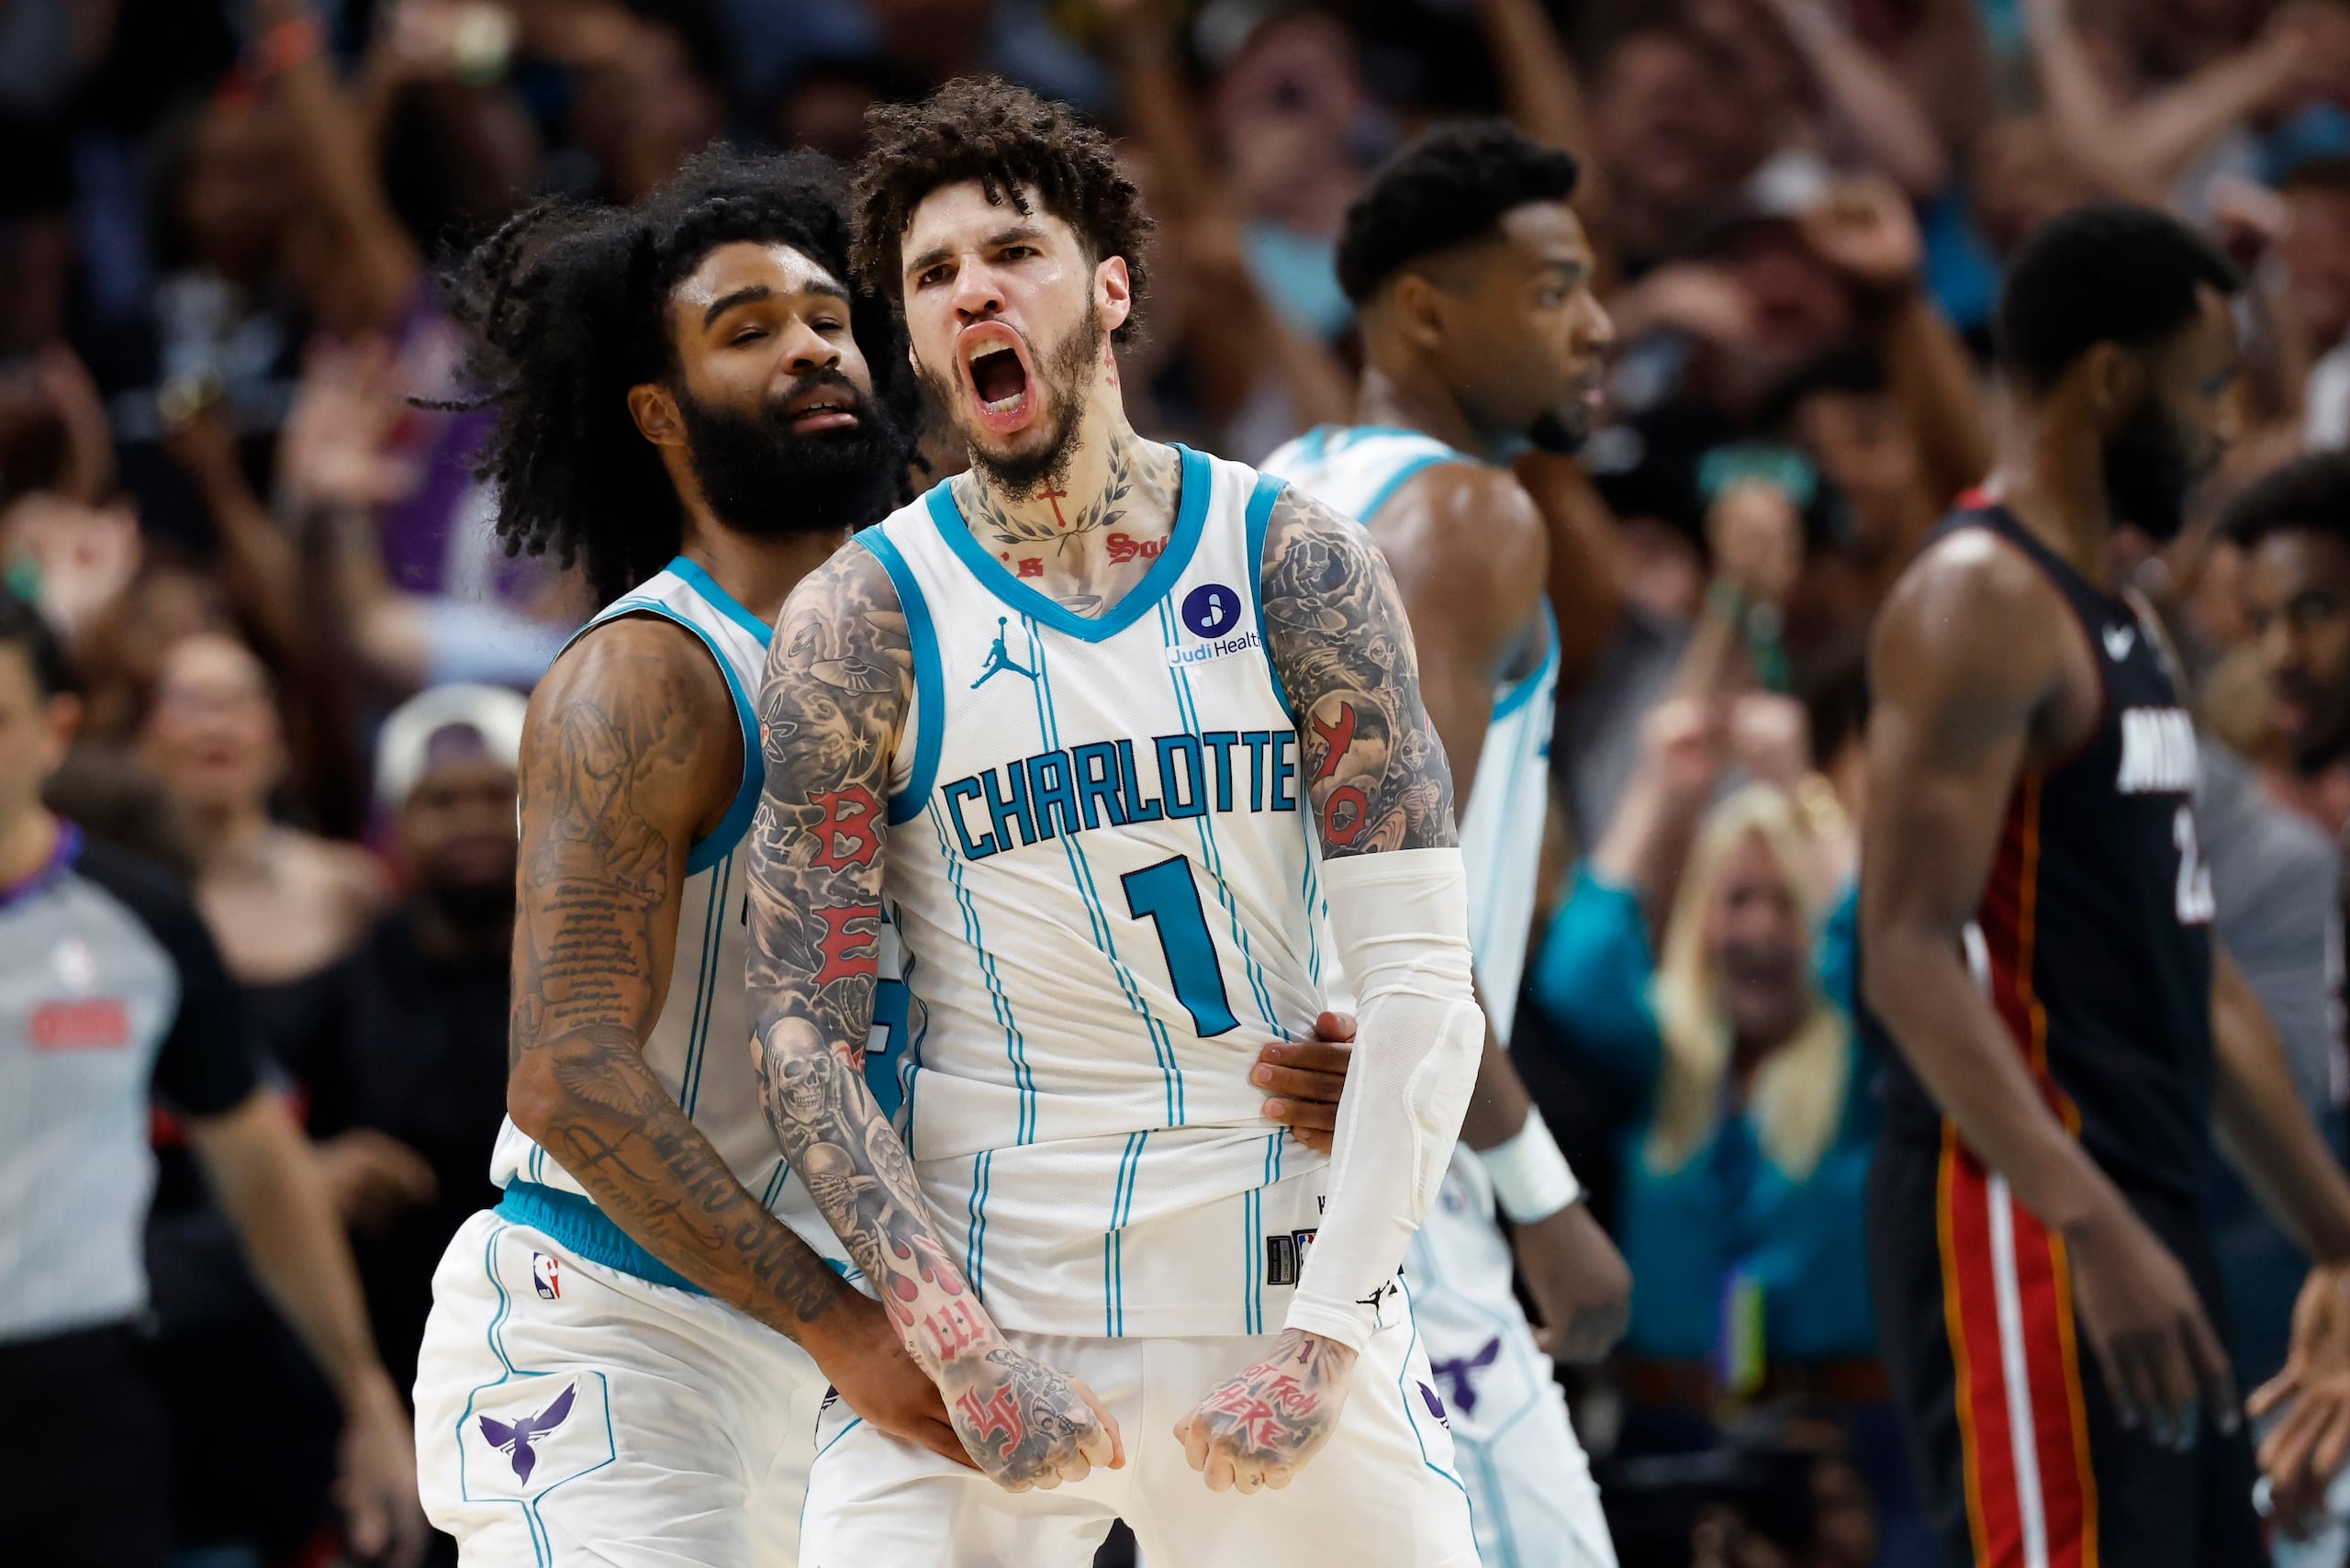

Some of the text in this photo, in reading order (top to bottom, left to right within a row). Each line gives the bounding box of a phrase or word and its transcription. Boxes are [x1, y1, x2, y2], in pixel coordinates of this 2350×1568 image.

[1171, 632, 1261, 664] Judi Healt
[941, 730, 1297, 861] CHARLOTTE
[1120, 854, 1241, 1038] 1
[1212, 1383, 1286, 1450] HERE
[1262, 1374, 1324, 1418] FROM
